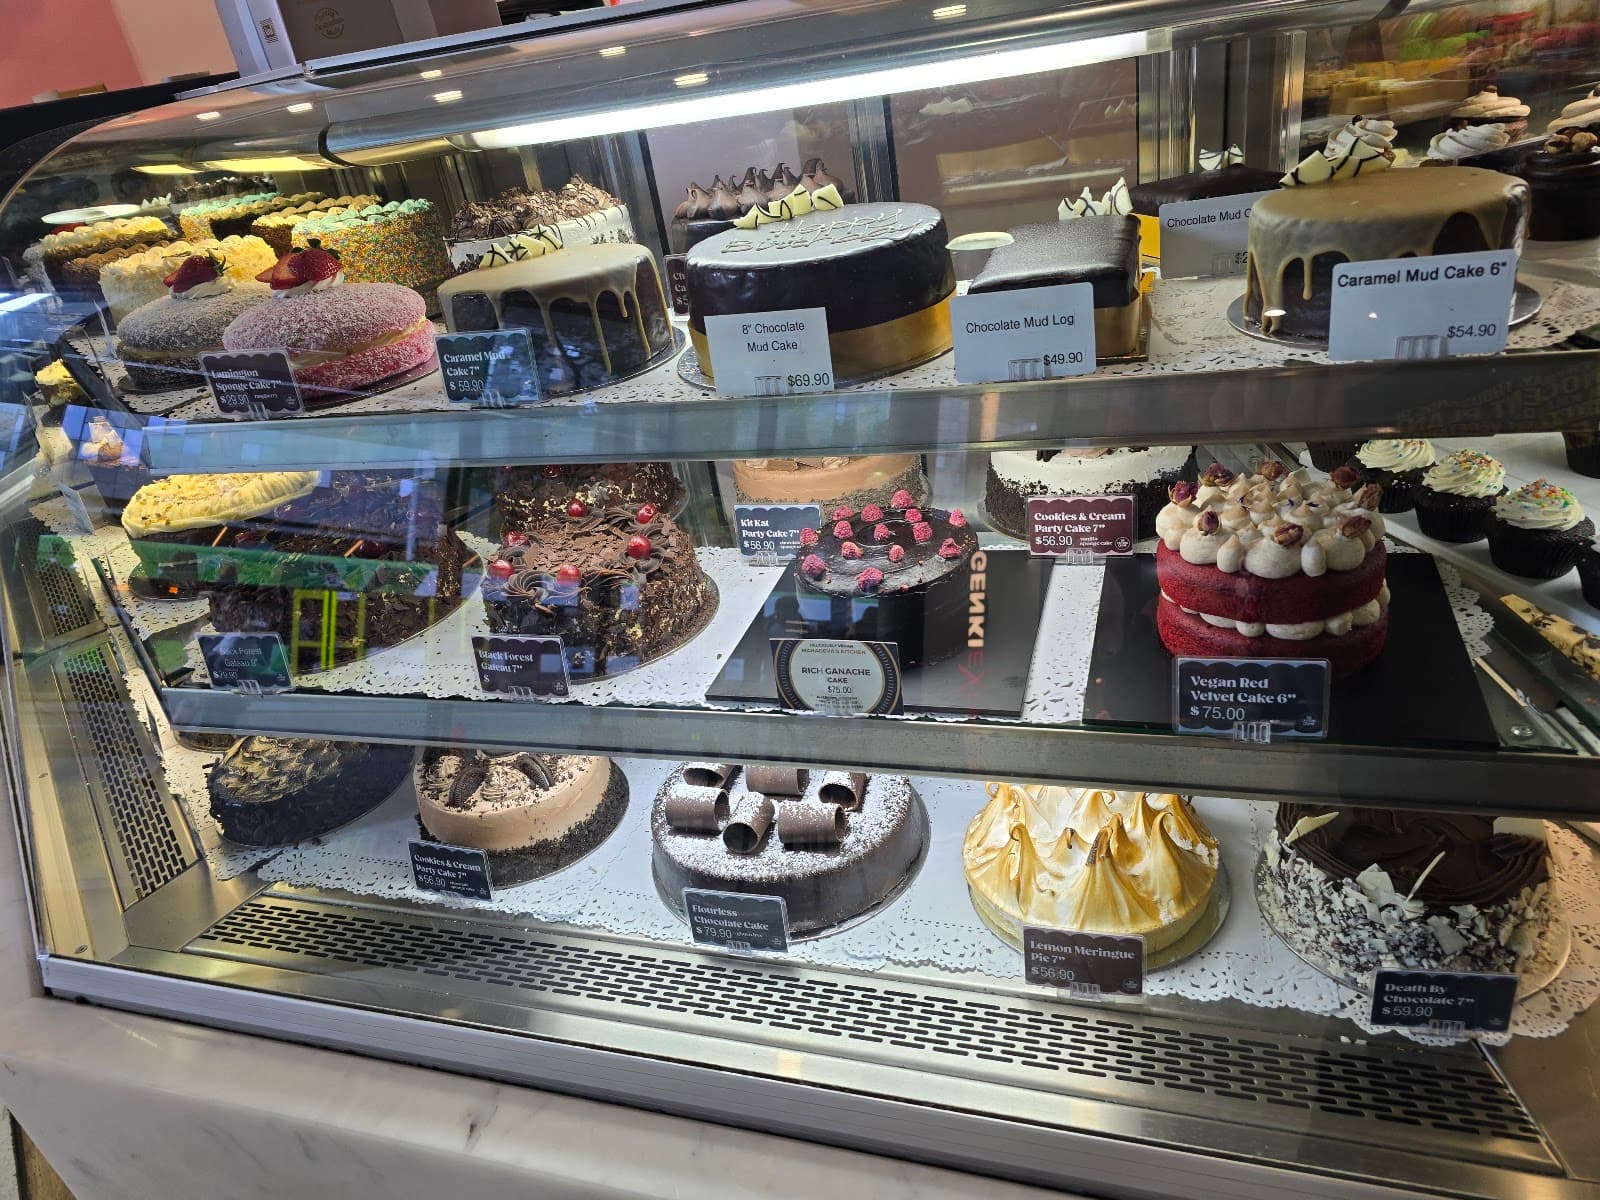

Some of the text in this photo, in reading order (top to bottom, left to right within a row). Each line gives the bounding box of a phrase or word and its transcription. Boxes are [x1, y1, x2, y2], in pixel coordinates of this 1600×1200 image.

[770, 208, 902, 237] Happy
[1167, 208, 1252, 228] Chocolate Mud C
[1234, 251, 1248, 264] $2
[673, 272, 685, 280] Ch
[1338, 270, 1400, 288] Caramel
[1406, 267, 1439, 283] Mud
[1445, 265, 1485, 279] Cake
[674, 284, 687, 292] Ca
[754, 322, 805, 334] Chocolate
[966, 314, 1074, 333] Chocolate Mud Log
[1447, 324, 1497, 338] $54.90
[747, 340, 798, 352] Mud Cake
[444, 351, 482, 362] Caramel
[1043, 351, 1083, 366] $49.90
[447, 367, 469, 376] Cake
[787, 372, 830, 387] $69.90
[216, 382, 248, 392] Sponge
[249, 381, 271, 390] Cake
[1034, 512, 1077, 521] Cookies
[740, 519, 769, 527] Kit Kat
[1034, 524, 1064, 534] Party
[1064, 524, 1092, 533] Cake
[742, 529, 765, 538] Party
[766, 529, 788, 538] Cake
[1035, 536, 1073, 546] $56.90
[479, 650, 533, 662] Black Forest
[481, 662, 511, 673] Gateau
[801, 667, 871, 676] RICH GANACHE
[1190, 675, 1269, 689] Vegan Red
[827, 686, 852, 694] $75.00
[1190, 690, 1235, 702] Velvet
[1237, 692, 1275, 704] Cake
[414, 854, 481, 872] Cookies & Cream
[416, 863, 436, 876] Party
[437, 869, 457, 878] Cake
[692, 904, 737, 917] Flourless
[694, 916, 769, 931] Chocolate Cake
[1030, 940, 1135, 960] Lemon Meringue
[1031, 952, 1050, 963] Pie
[1031, 966, 1074, 981] $56.90
[1385, 983, 1448, 994] Death By
[1383, 995, 1453, 1005] Chocolate
